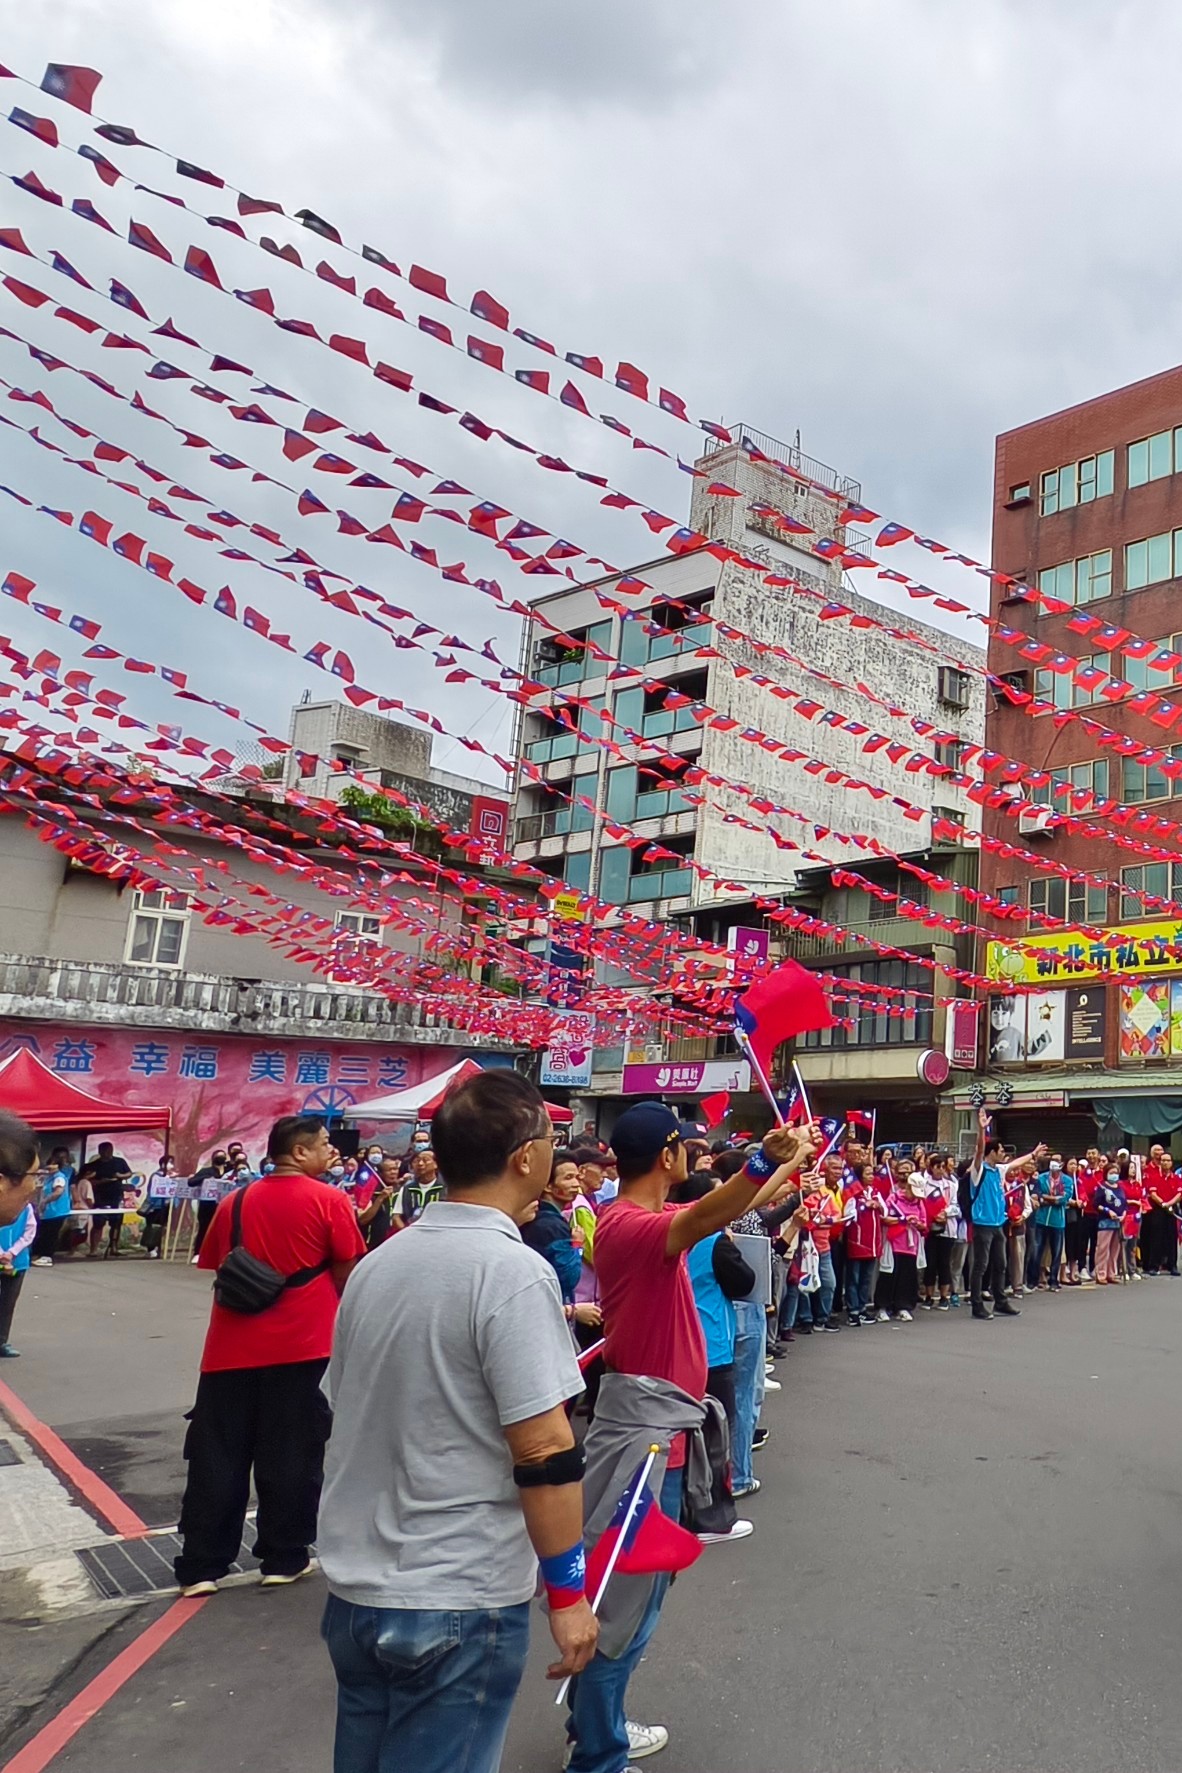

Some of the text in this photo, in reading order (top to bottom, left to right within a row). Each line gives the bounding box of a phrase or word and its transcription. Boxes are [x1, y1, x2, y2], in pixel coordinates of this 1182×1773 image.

[129, 1041, 220, 1081] 幸福
[248, 1049, 410, 1088] 美麗三芝
